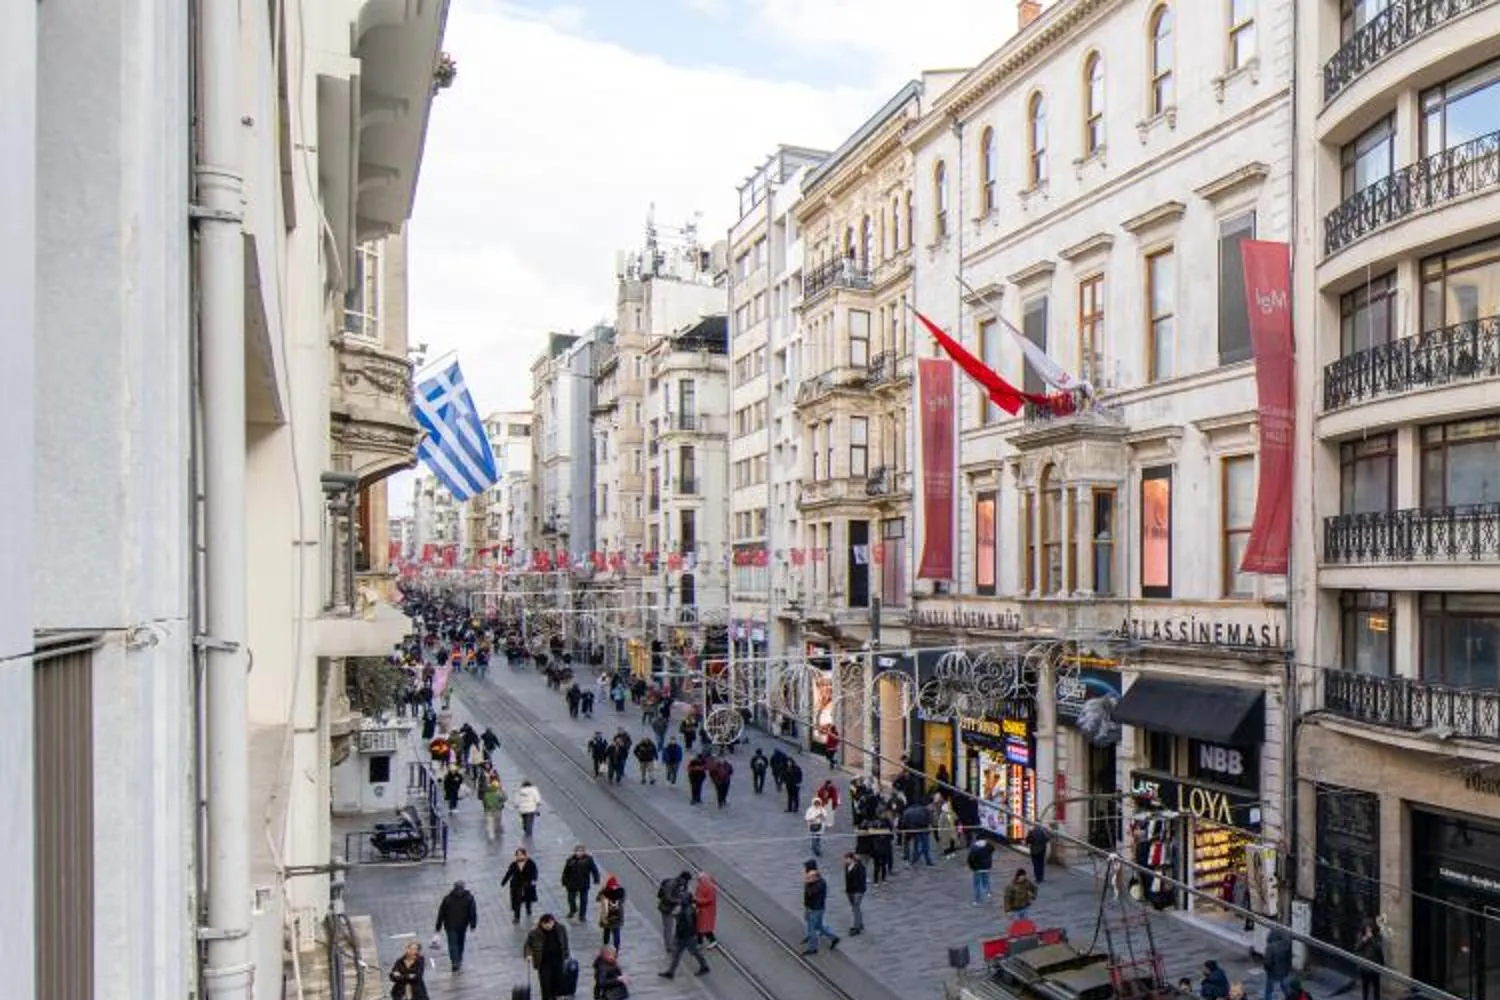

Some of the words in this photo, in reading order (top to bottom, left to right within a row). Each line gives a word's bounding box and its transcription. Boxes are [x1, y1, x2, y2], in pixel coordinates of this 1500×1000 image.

[1121, 618, 1173, 641] ATLAS
[1179, 615, 1281, 648] SİNEMASI
[1200, 743, 1244, 775] NBB
[1177, 783, 1233, 825] LOYA
